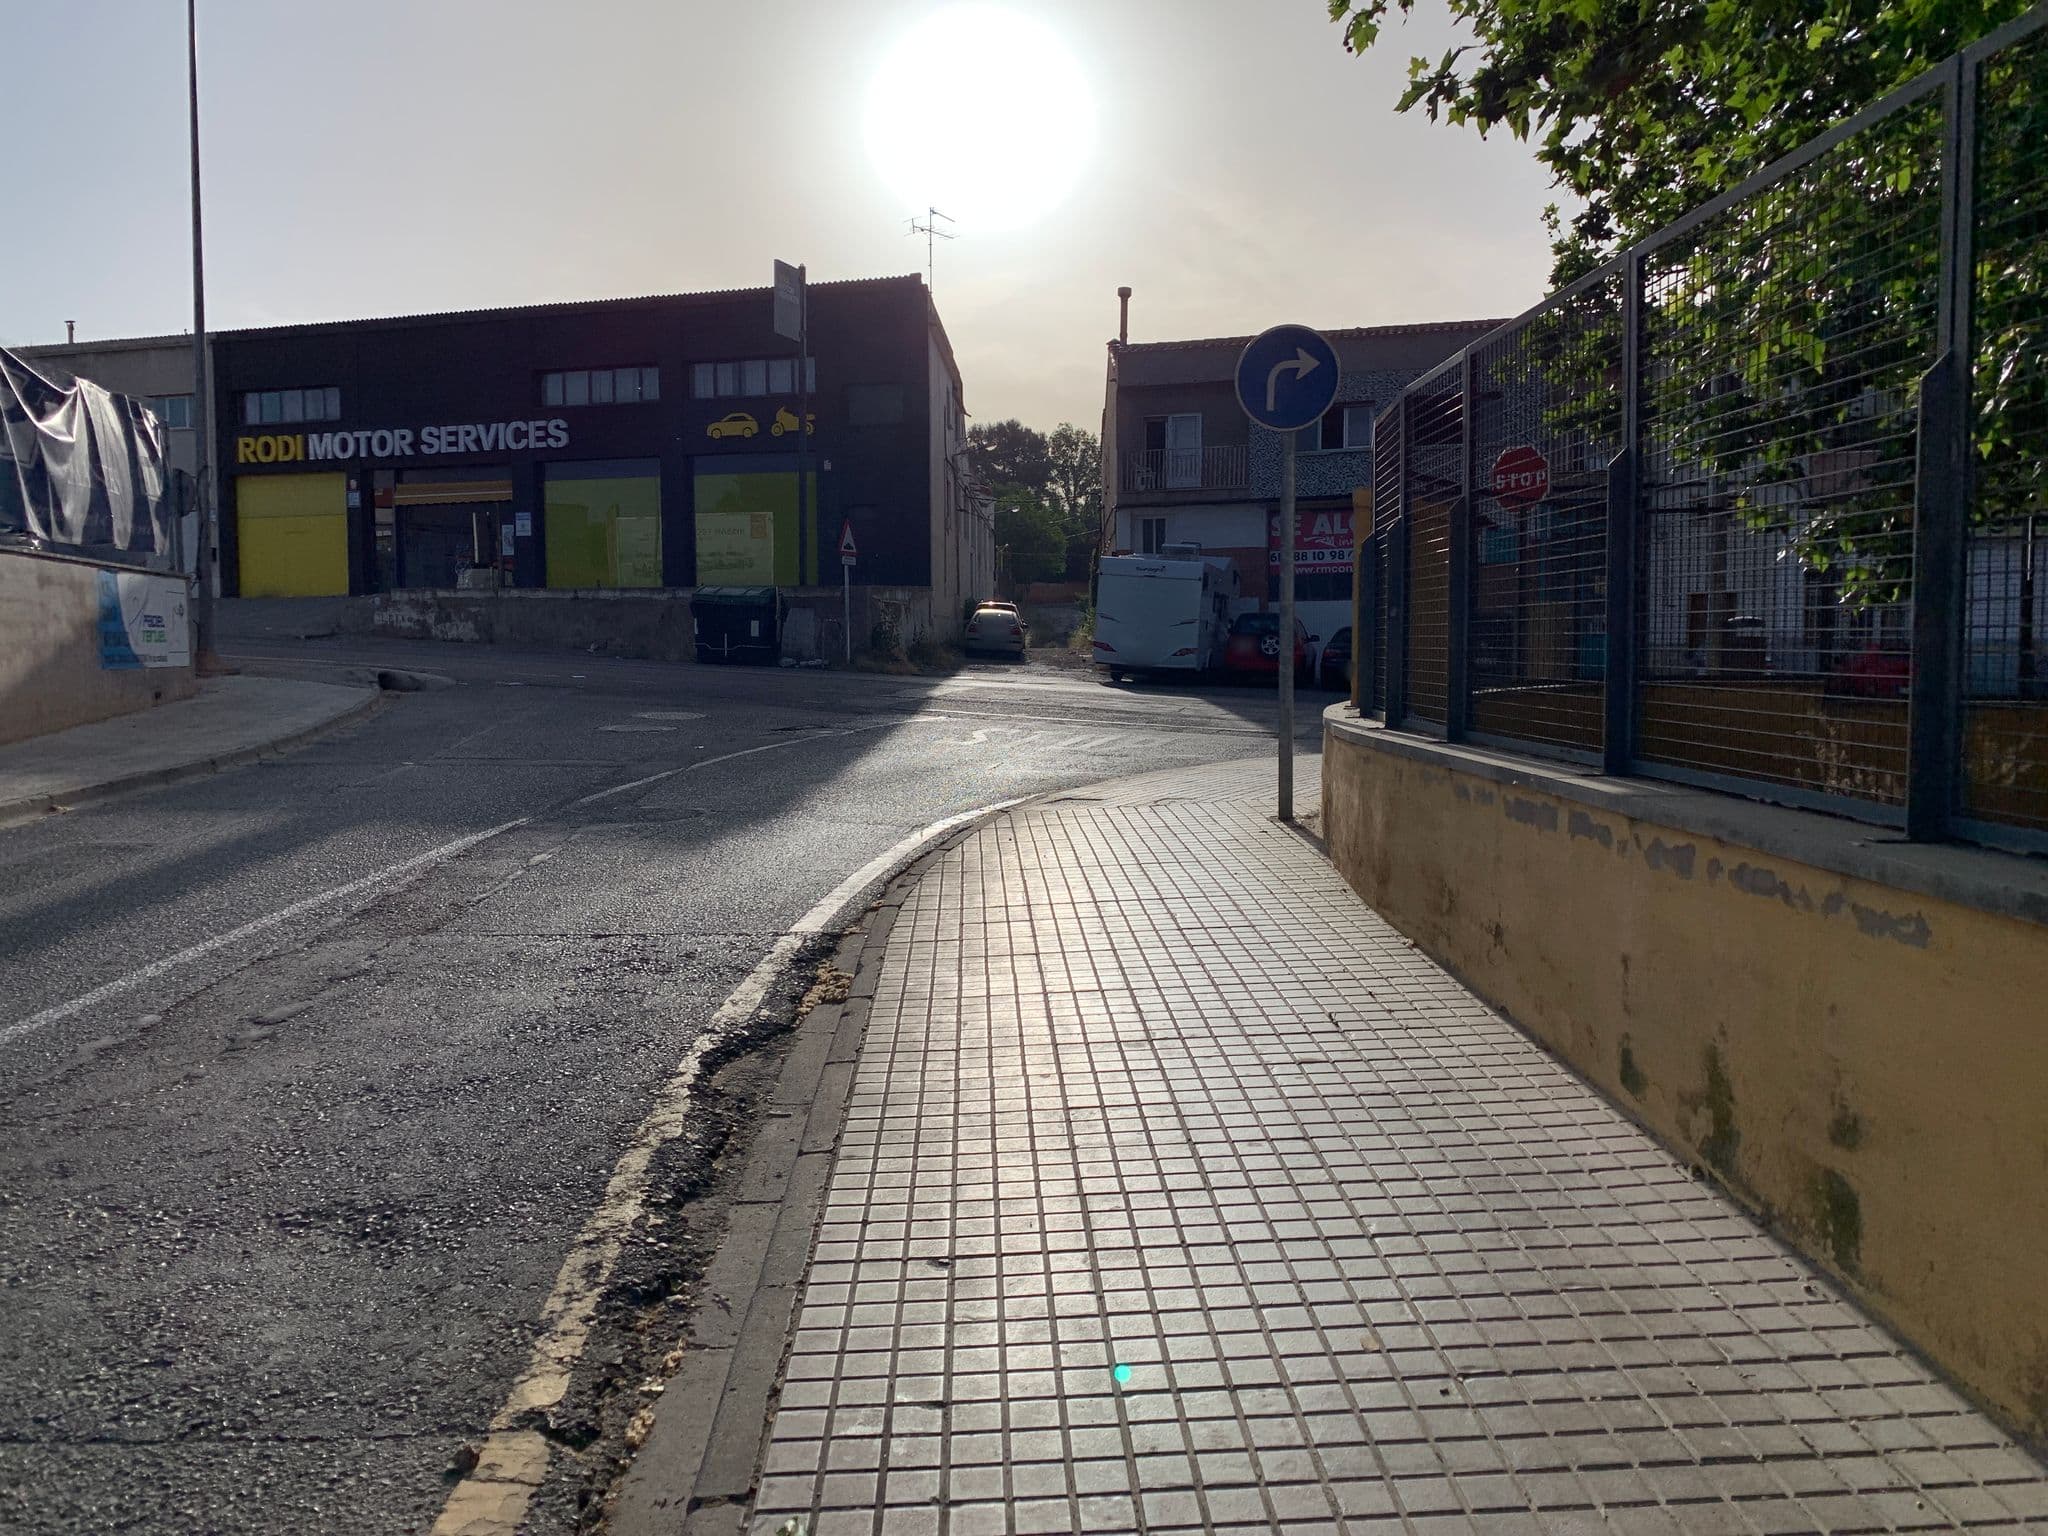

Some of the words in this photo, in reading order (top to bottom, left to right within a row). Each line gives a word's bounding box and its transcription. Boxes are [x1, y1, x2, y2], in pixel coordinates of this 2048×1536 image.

[237, 433, 304, 463] RODI
[308, 428, 416, 461] MOTOR
[420, 418, 570, 455] SERVICES
[1496, 470, 1546, 490] STOP
[1312, 512, 1354, 535] AL
[1329, 550, 1345, 560] 98
